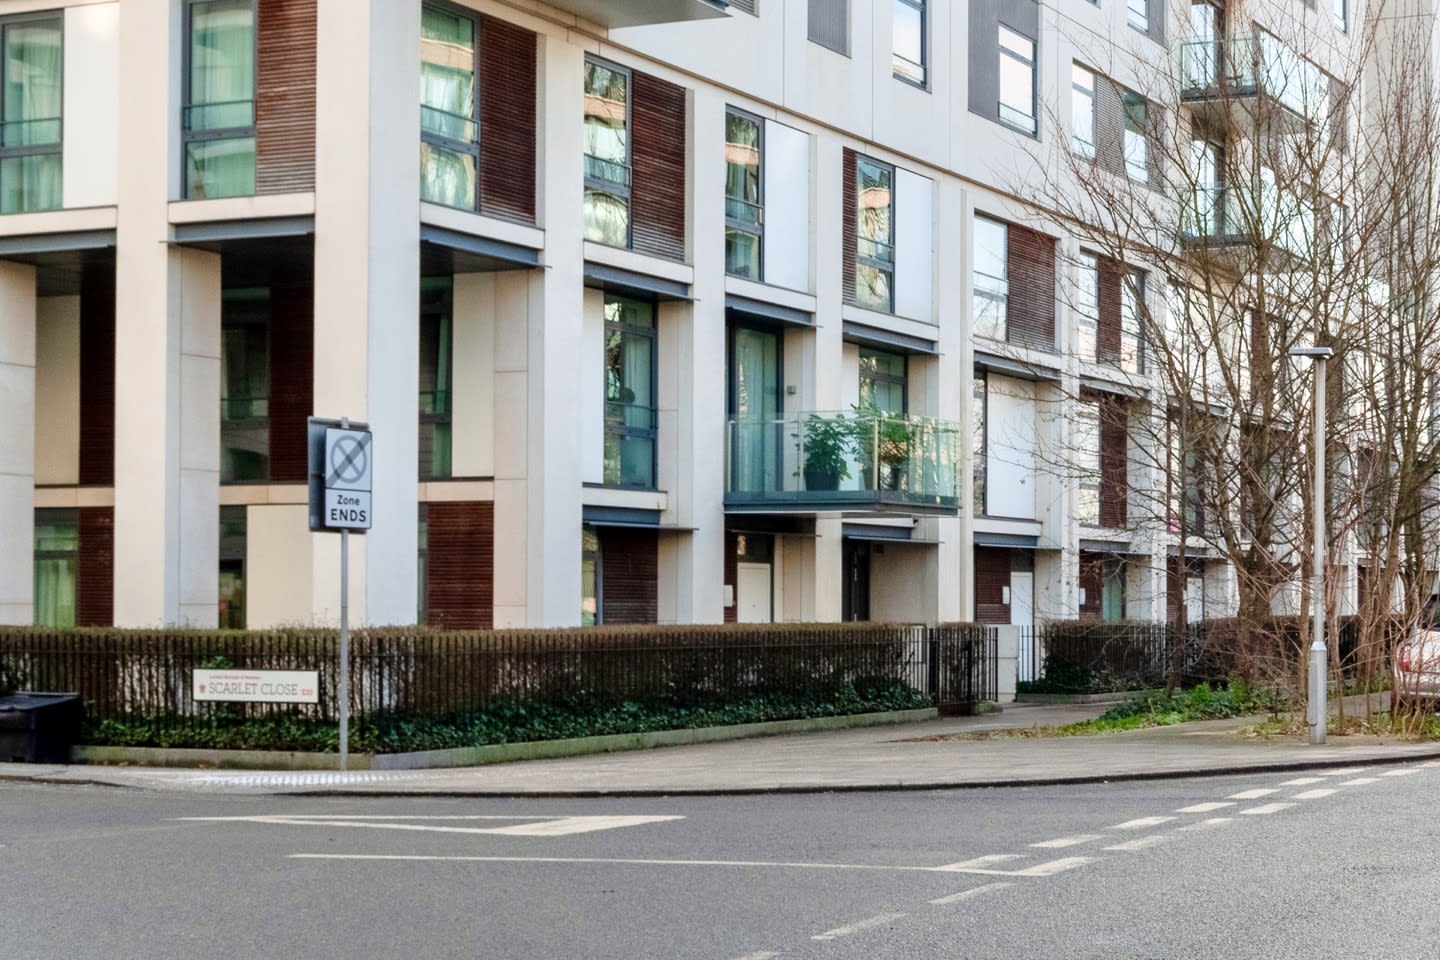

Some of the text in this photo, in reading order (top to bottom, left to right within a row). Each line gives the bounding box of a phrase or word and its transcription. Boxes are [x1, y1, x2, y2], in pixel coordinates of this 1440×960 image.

[337, 494, 360, 506] Zone
[330, 508, 367, 522] ENDS
[208, 682, 258, 695] SCARLET
[260, 683, 298, 696] CLOSE
